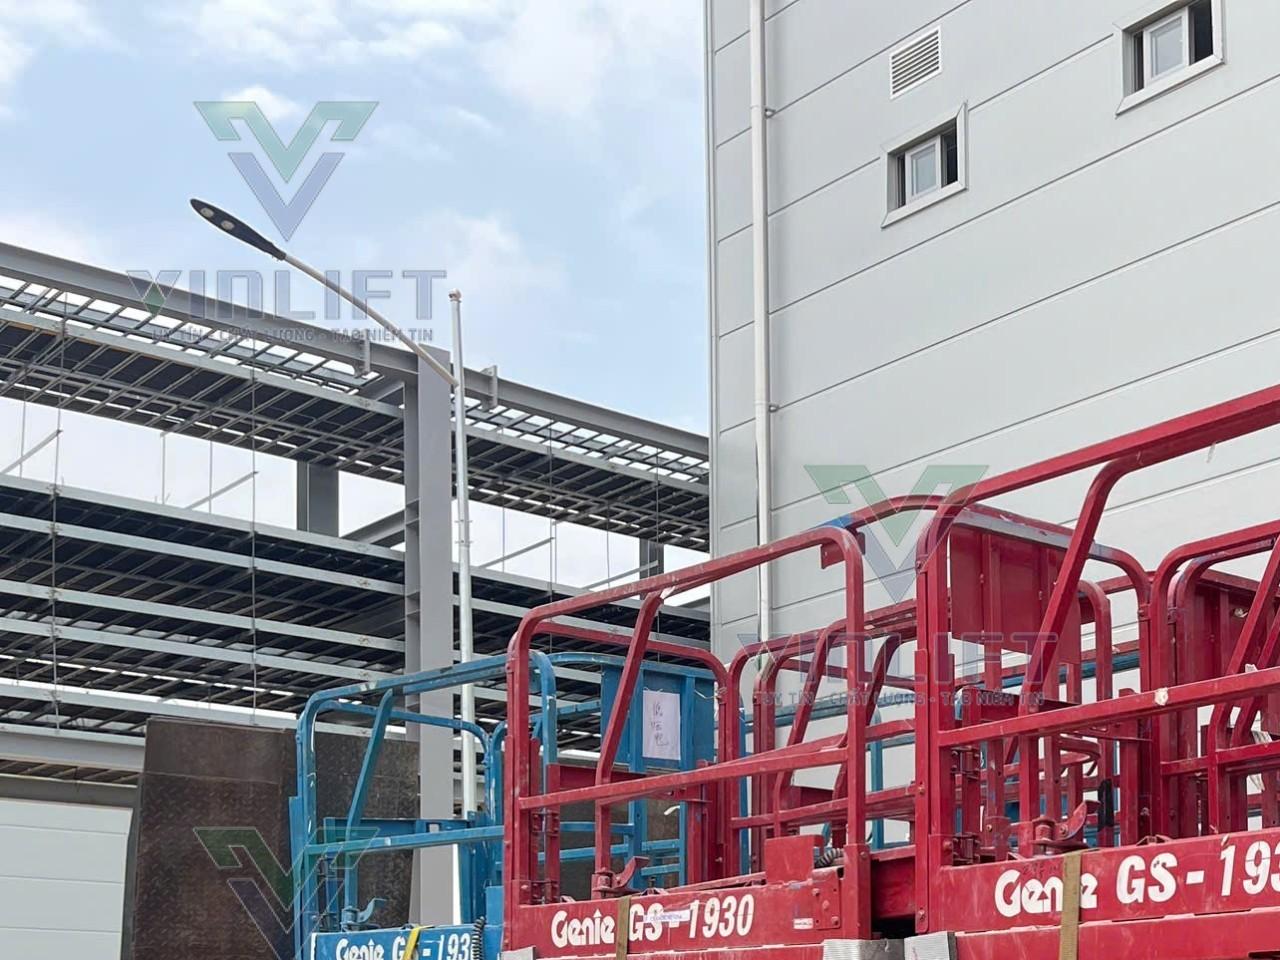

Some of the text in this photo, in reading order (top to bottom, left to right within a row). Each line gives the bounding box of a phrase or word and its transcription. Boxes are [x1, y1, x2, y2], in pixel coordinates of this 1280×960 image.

[994, 868, 1098, 917] Gene
[1115, 852, 1178, 904] GS
[551, 909, 615, 948] Genie
[689, 894, 753, 939] 1930
